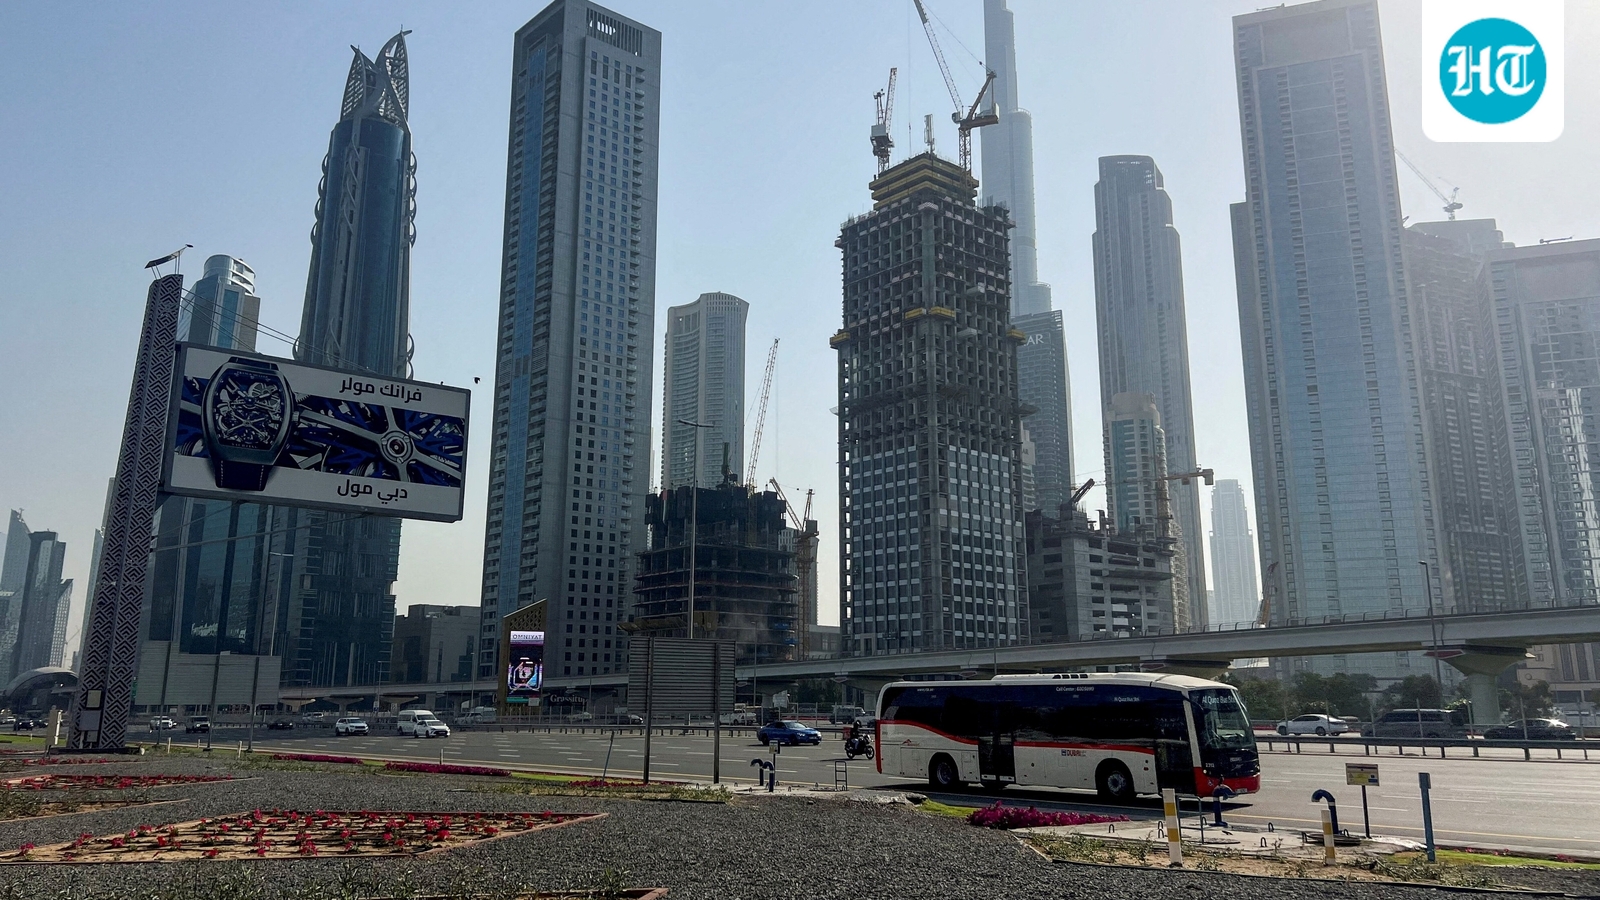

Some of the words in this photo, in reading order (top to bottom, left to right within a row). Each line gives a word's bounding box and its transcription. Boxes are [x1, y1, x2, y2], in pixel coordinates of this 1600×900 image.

[1024, 334, 1044, 346] AR
[339, 377, 375, 396] مولر
[380, 384, 422, 403] فرانك
[337, 479, 373, 498] مول
[377, 488, 408, 505] دبي
